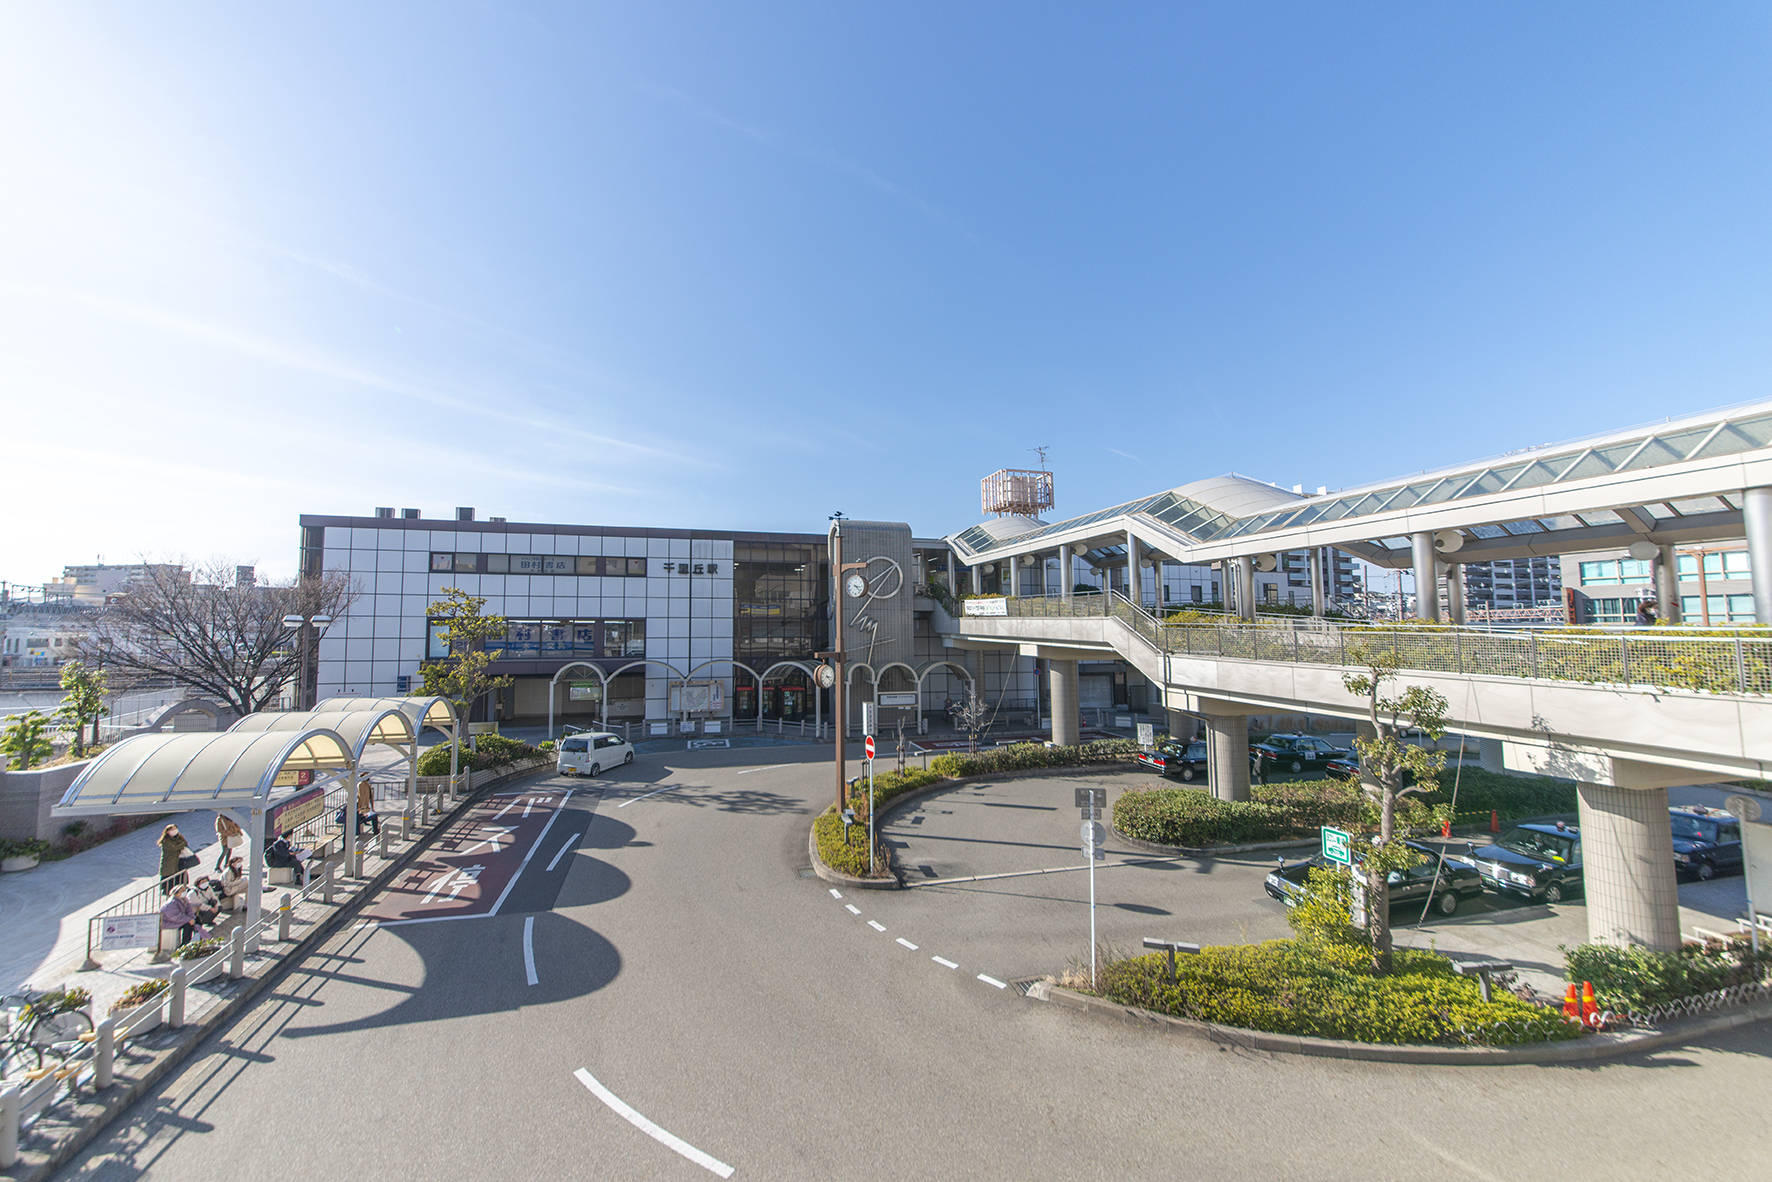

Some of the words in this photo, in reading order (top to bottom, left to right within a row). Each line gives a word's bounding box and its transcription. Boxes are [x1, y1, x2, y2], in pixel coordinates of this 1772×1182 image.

[521, 561, 566, 569] 田村書店
[663, 562, 719, 575] 千里丘駅
[420, 796, 553, 905] バス停
